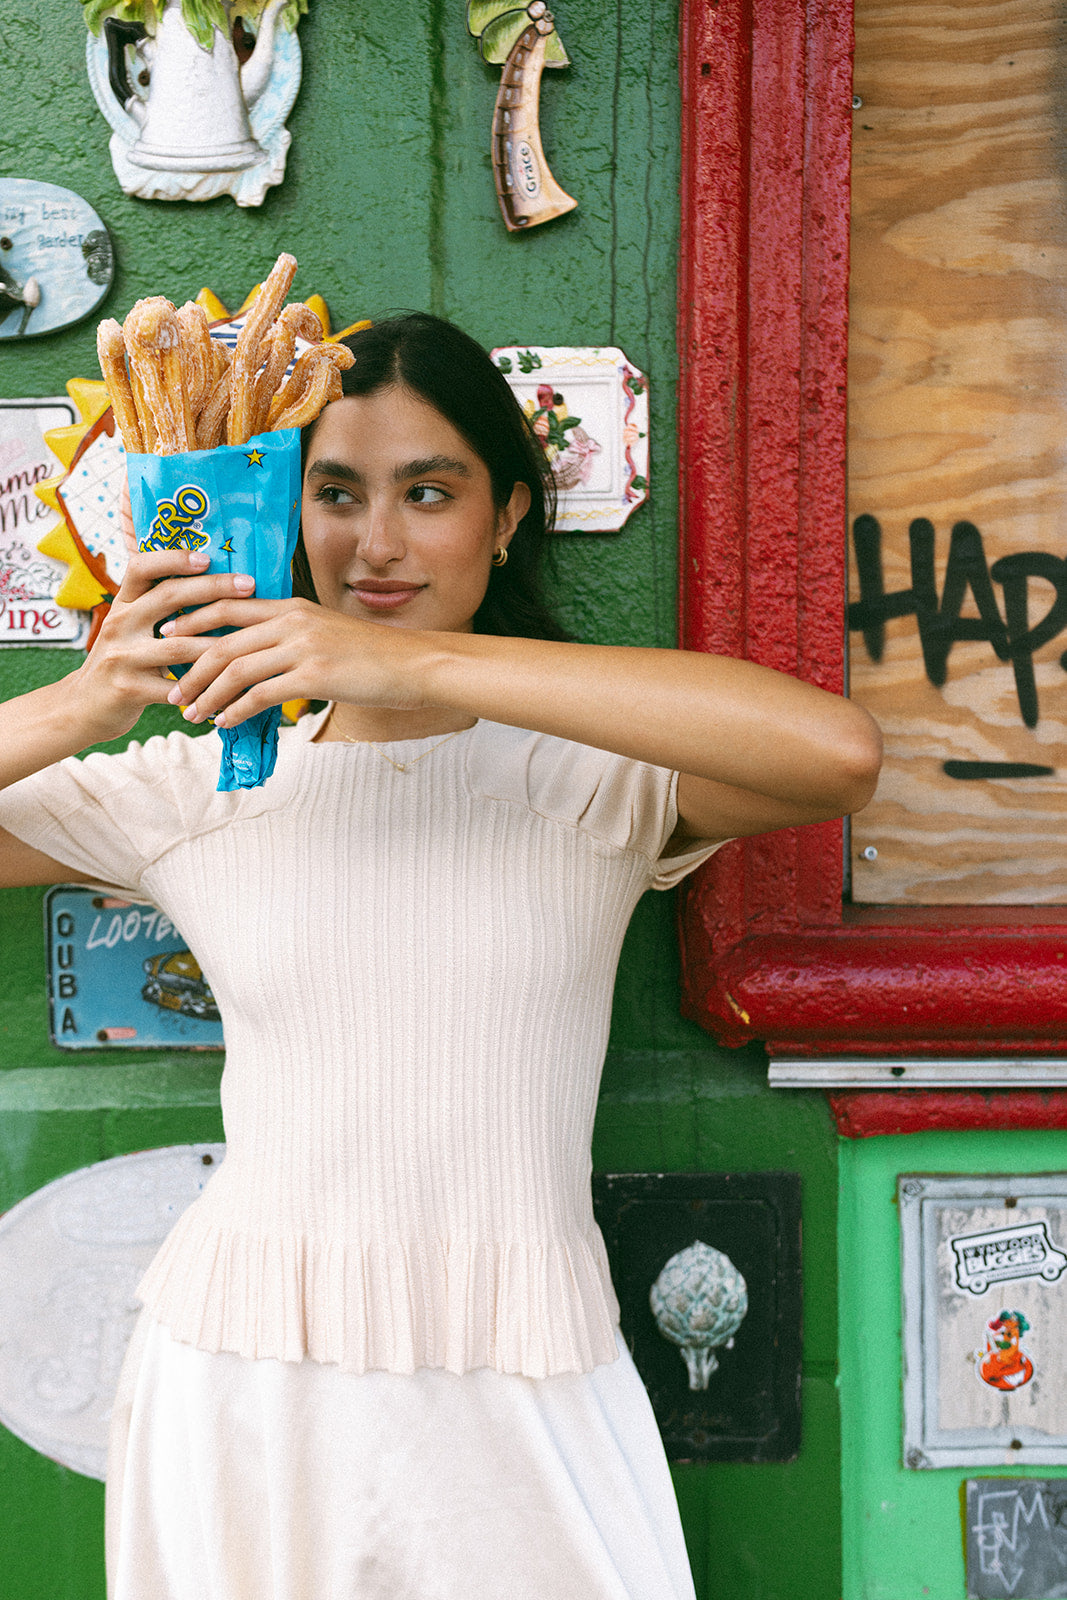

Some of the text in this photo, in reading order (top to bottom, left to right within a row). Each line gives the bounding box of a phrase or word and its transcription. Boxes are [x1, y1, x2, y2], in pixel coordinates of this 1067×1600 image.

[519, 147, 538, 192] Grace
[42, 202, 78, 221] best
[0, 463, 54, 497] mp
[0, 600, 62, 634] ine
[847, 513, 1067, 730] HAP
[57, 912, 79, 1034] CUBA
